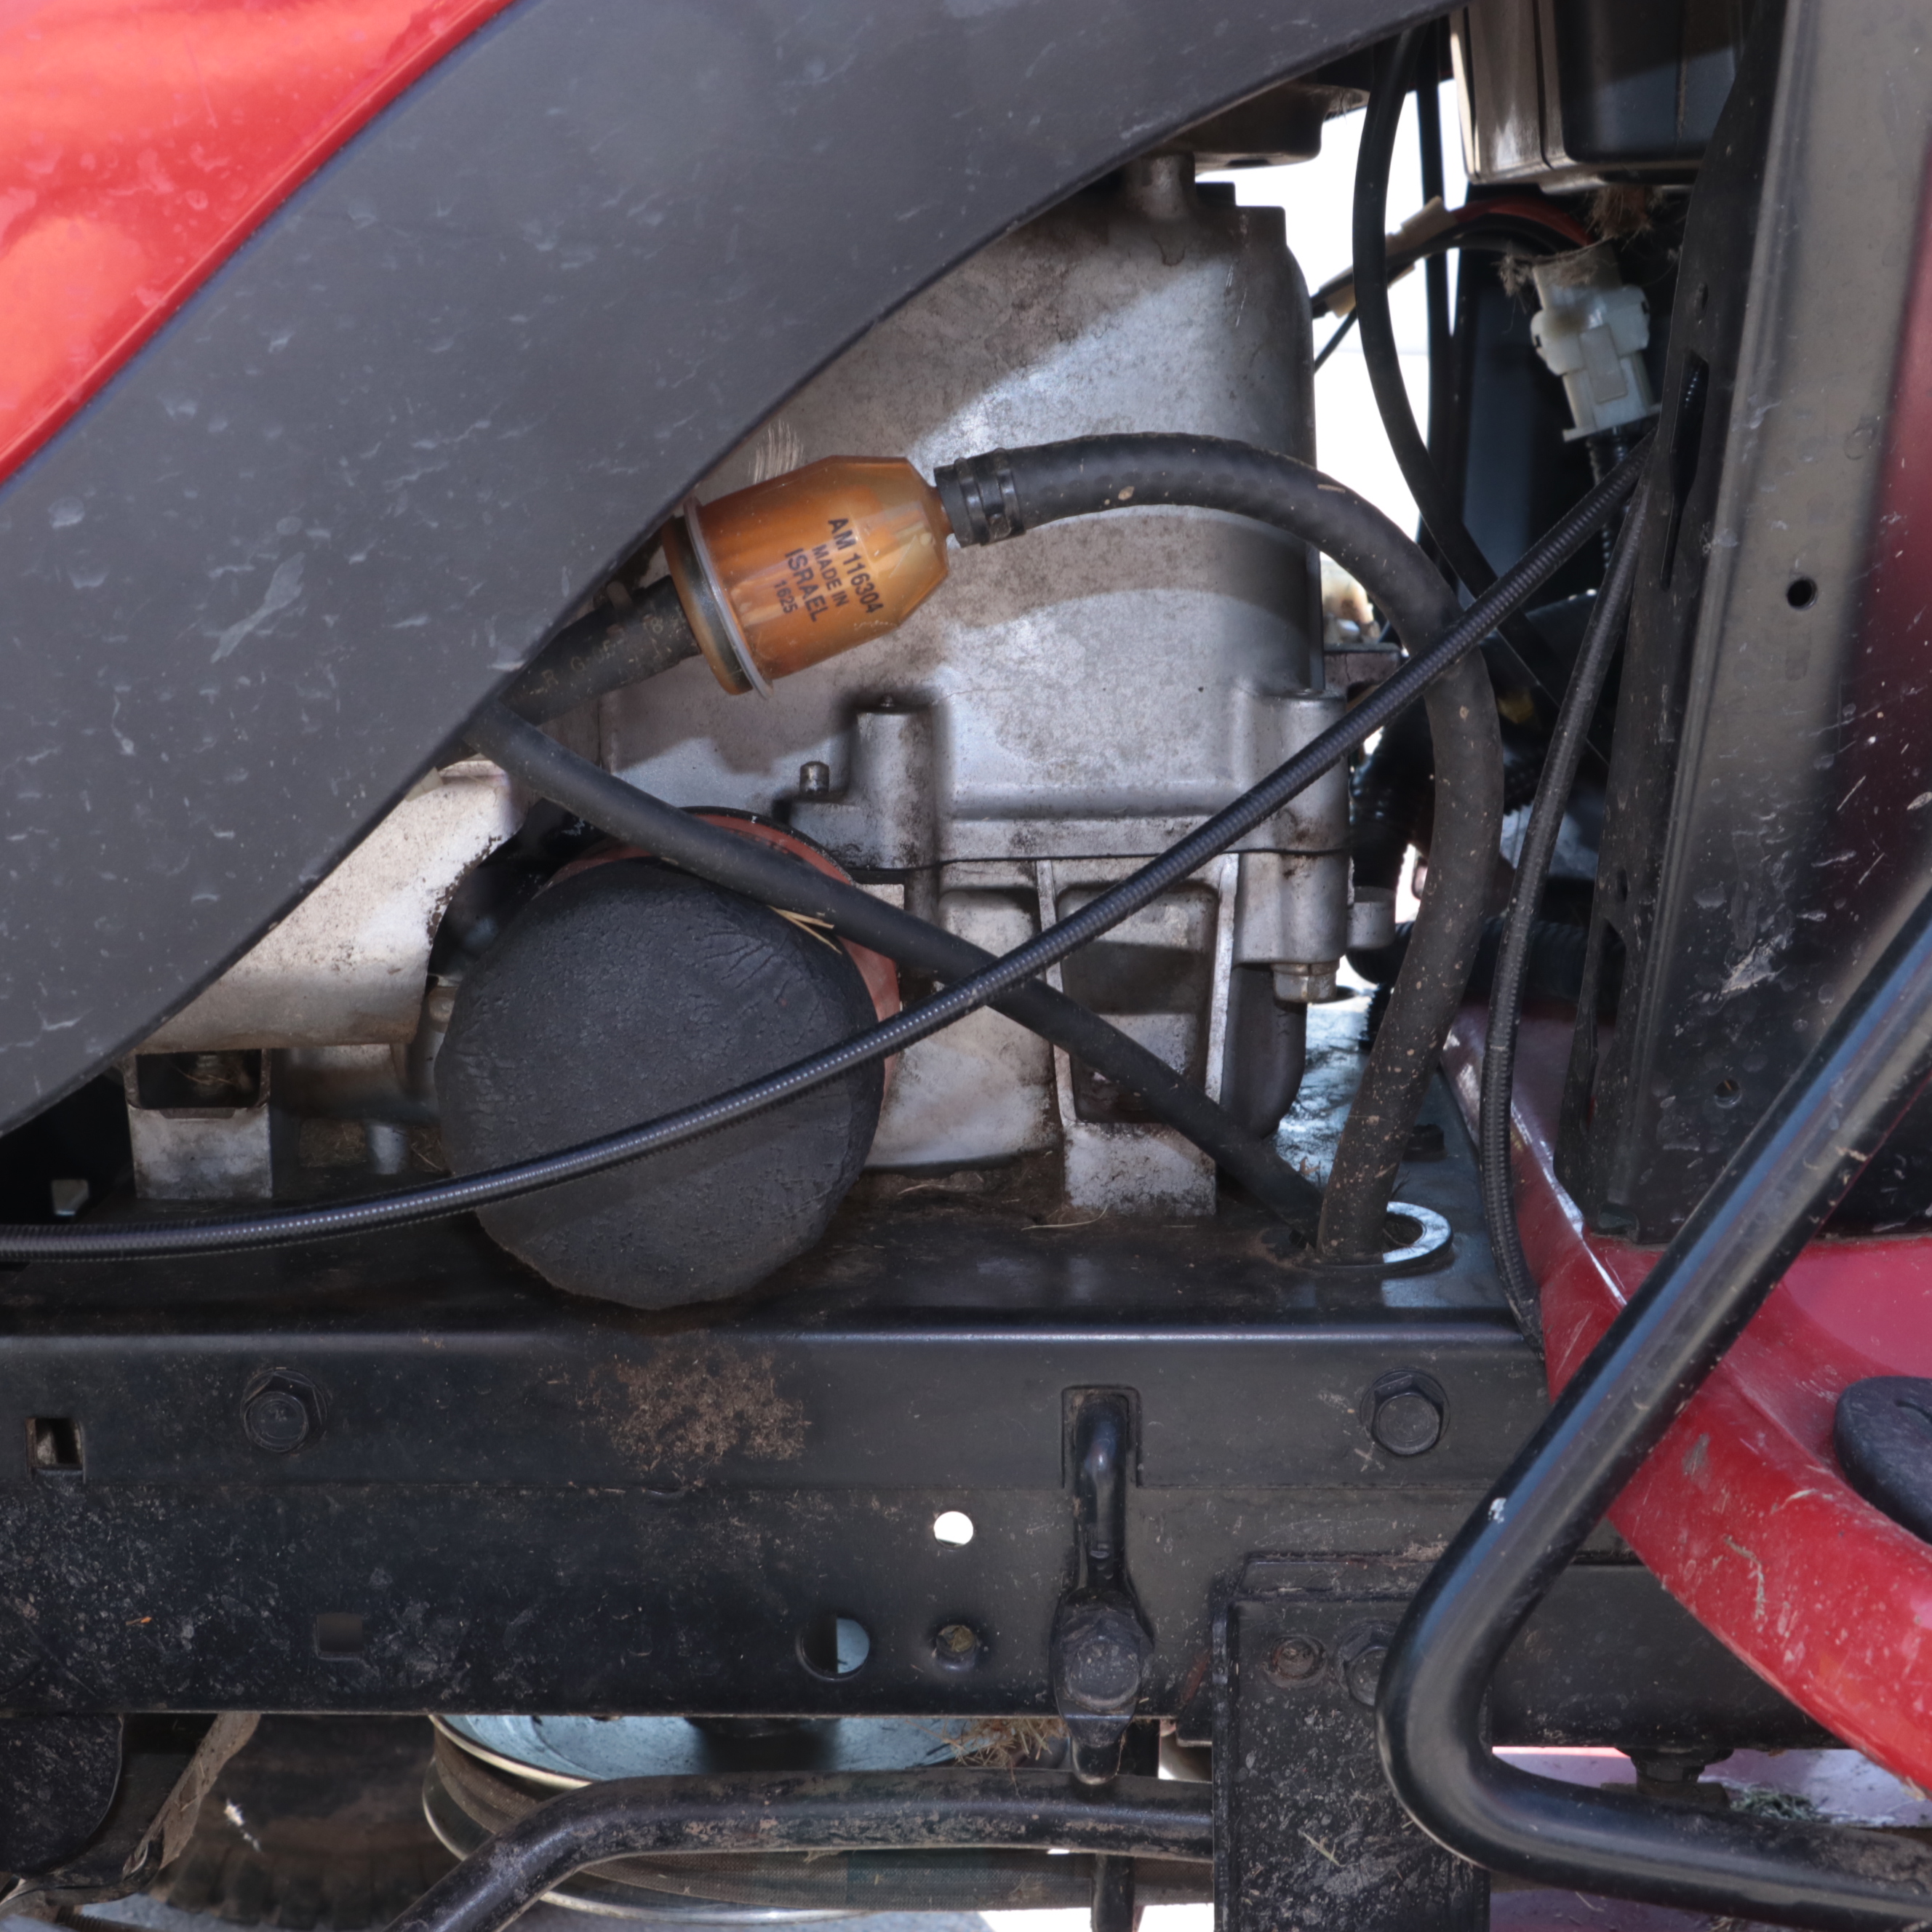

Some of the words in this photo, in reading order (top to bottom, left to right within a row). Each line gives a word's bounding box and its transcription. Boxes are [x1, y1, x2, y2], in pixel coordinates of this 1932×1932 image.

[828, 518, 857, 551] AM
[774, 580, 799, 614] 1625
[785, 548, 829, 623] ISRAEL
[812, 543, 842, 591] MADE
[831, 591, 850, 607] IN
[842, 553, 884, 614] 116304
